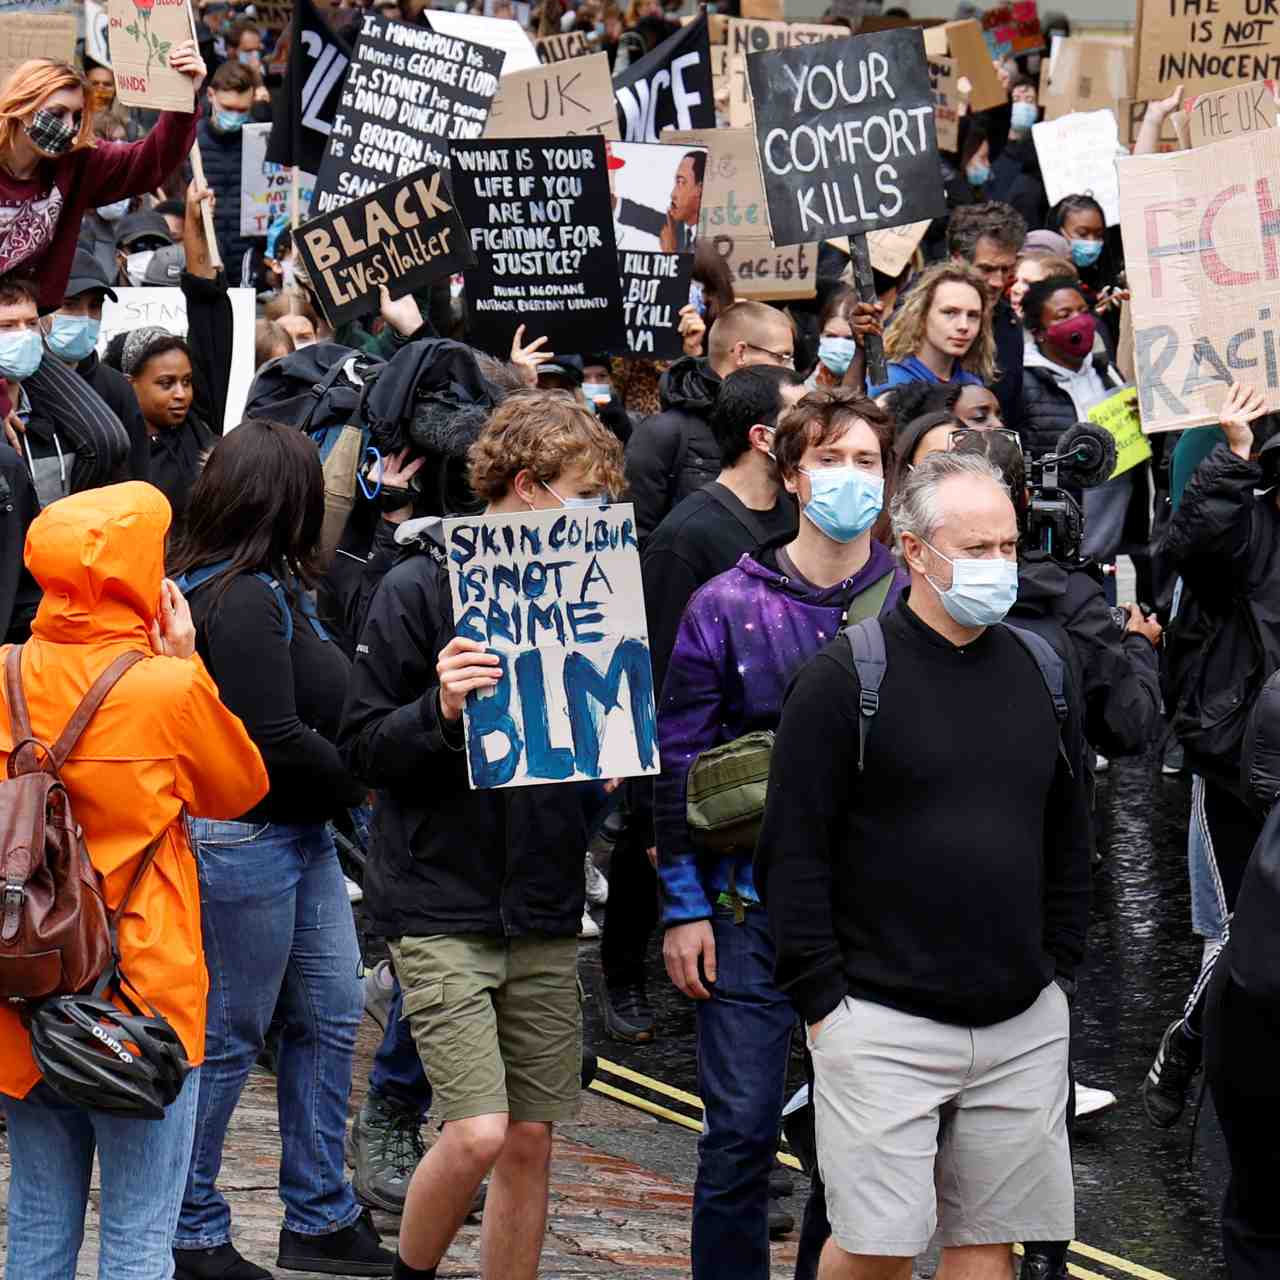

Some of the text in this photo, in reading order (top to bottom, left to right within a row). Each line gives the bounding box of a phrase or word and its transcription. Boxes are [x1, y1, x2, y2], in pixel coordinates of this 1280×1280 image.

[361, 15, 484, 68] In MINNEAPOLIS his
[1190, 20, 1274, 46] IS NOT
[347, 62, 368, 93] In
[430, 86, 451, 111] his
[452, 101, 488, 121] name
[358, 44, 499, 97] name is GEORGE FLOYD
[783, 52, 896, 113] YOUR
[342, 90, 354, 107] is
[354, 90, 398, 121] DAVID
[526, 71, 592, 121] UK
[1196, 87, 1276, 138] THE UK
[329, 138, 394, 174] is SEAN
[332, 114, 353, 137] In
[359, 121, 424, 162] BRIXTON
[515, 148, 535, 170] IS
[542, 147, 596, 170] YOUR
[765, 106, 933, 176] COMFORT
[474, 176, 583, 198] LIFE IF YOU
[488, 198, 575, 224] ARE NOT
[797, 164, 904, 232] KILLS
[303, 171, 453, 272] BLACK
[470, 224, 603, 251] FIGHTING FOR
[382, 227, 452, 278] Matter
[624, 252, 680, 278] KILL THE
[636, 304, 673, 327] KILL
[451, 513, 640, 569] SKIN COLOUR
[457, 554, 614, 606] IS NOT A
[453, 597, 608, 647] CRIME
[465, 634, 657, 789] BLM
